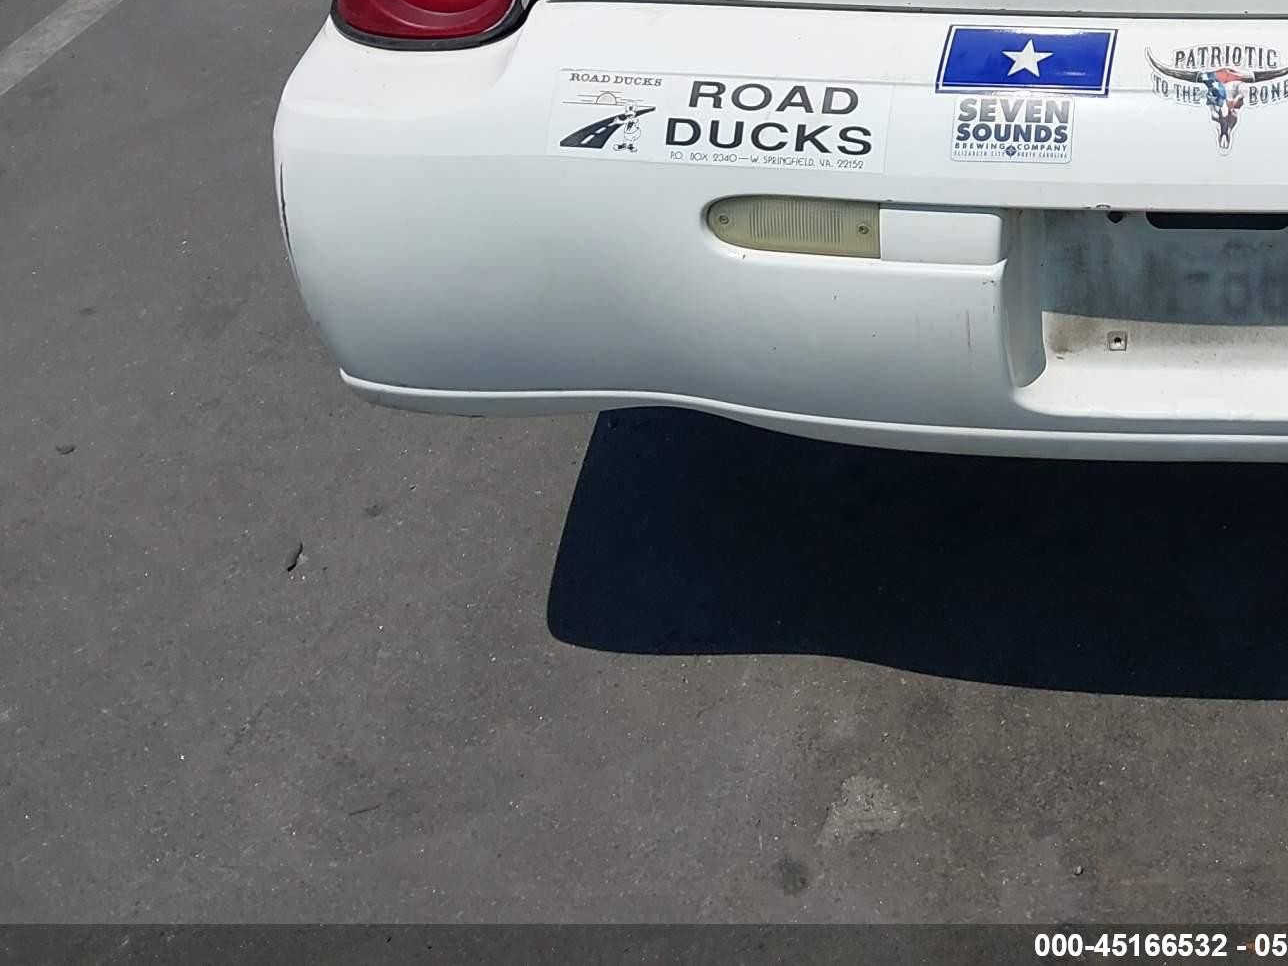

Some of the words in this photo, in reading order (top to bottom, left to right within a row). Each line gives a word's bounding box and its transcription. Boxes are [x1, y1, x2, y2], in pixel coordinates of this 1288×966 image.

[1174, 45, 1278, 69] PATRIOTIC
[570, 72, 611, 84] ROAD
[613, 75, 663, 87] DUCKS
[1153, 74, 1169, 97] TO
[1173, 83, 1201, 104] THE
[688, 80, 859, 115] ROAD
[957, 97, 1071, 124] SEVEN
[665, 117, 872, 156] DUCKS
[955, 122, 1068, 144] SOUNDS
[954, 142, 1006, 150] BREWING
[1017, 143, 1068, 152] COMPANY
[836, 159, 864, 170] 22152
